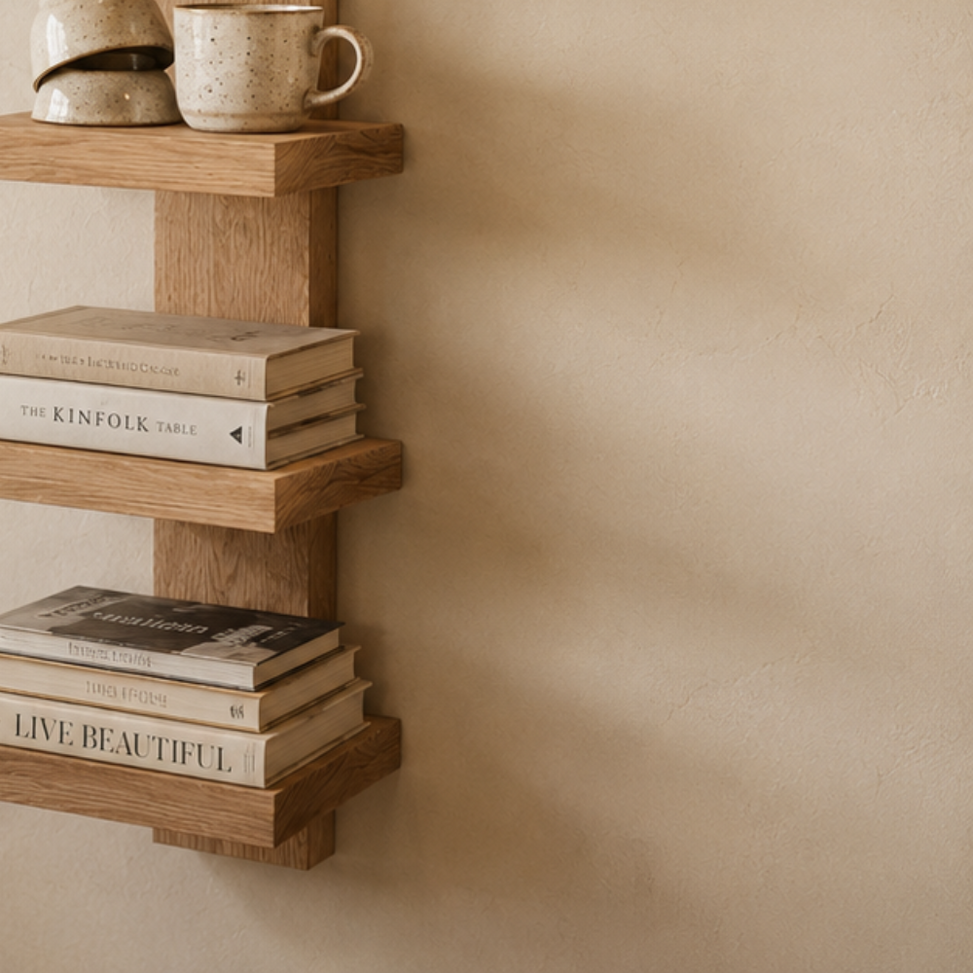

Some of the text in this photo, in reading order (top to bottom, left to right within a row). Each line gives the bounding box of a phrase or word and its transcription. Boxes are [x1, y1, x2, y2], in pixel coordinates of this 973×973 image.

[20, 404, 198, 436] THE KINFOLK TABLE
[15, 713, 74, 746] LIVE
[82, 724, 232, 773] BEAUTIFUL
